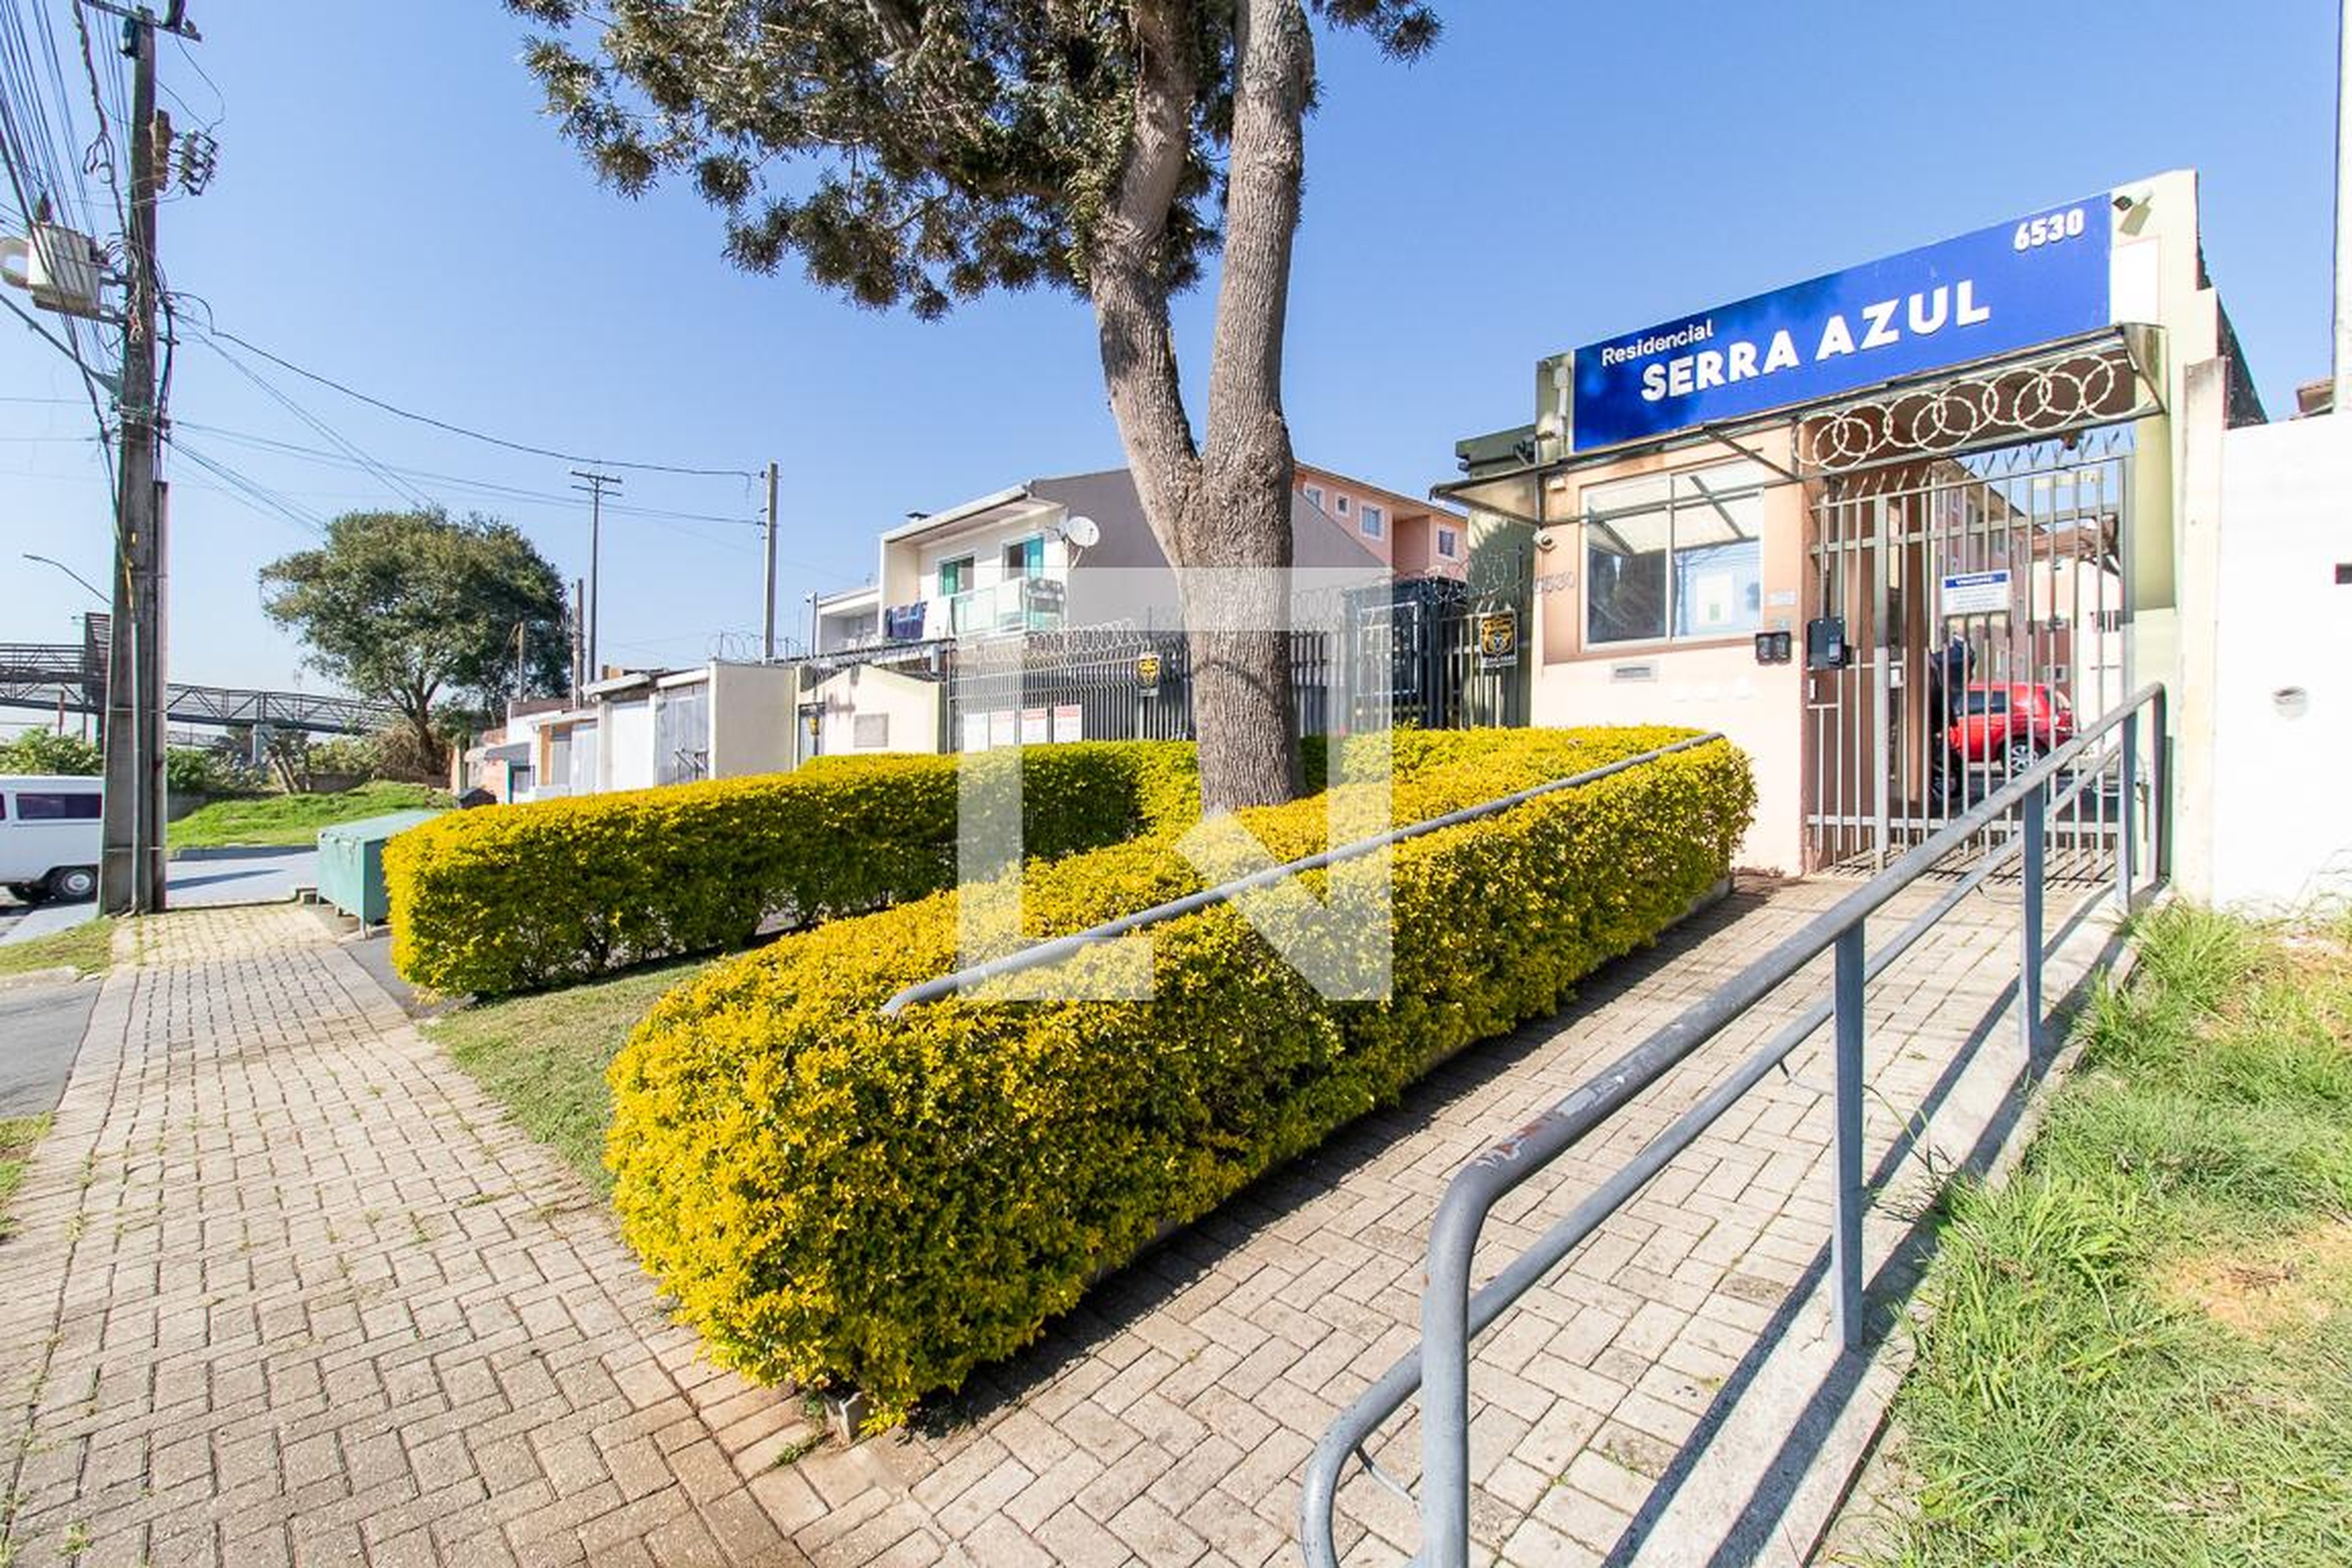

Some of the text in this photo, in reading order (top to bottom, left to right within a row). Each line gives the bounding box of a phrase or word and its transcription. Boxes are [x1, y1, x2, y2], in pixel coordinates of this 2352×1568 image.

[2014, 208, 2084, 251] 6530
[1602, 318, 1714, 367] Residencial
[1641, 279, 1990, 402] SERRA AZUL
